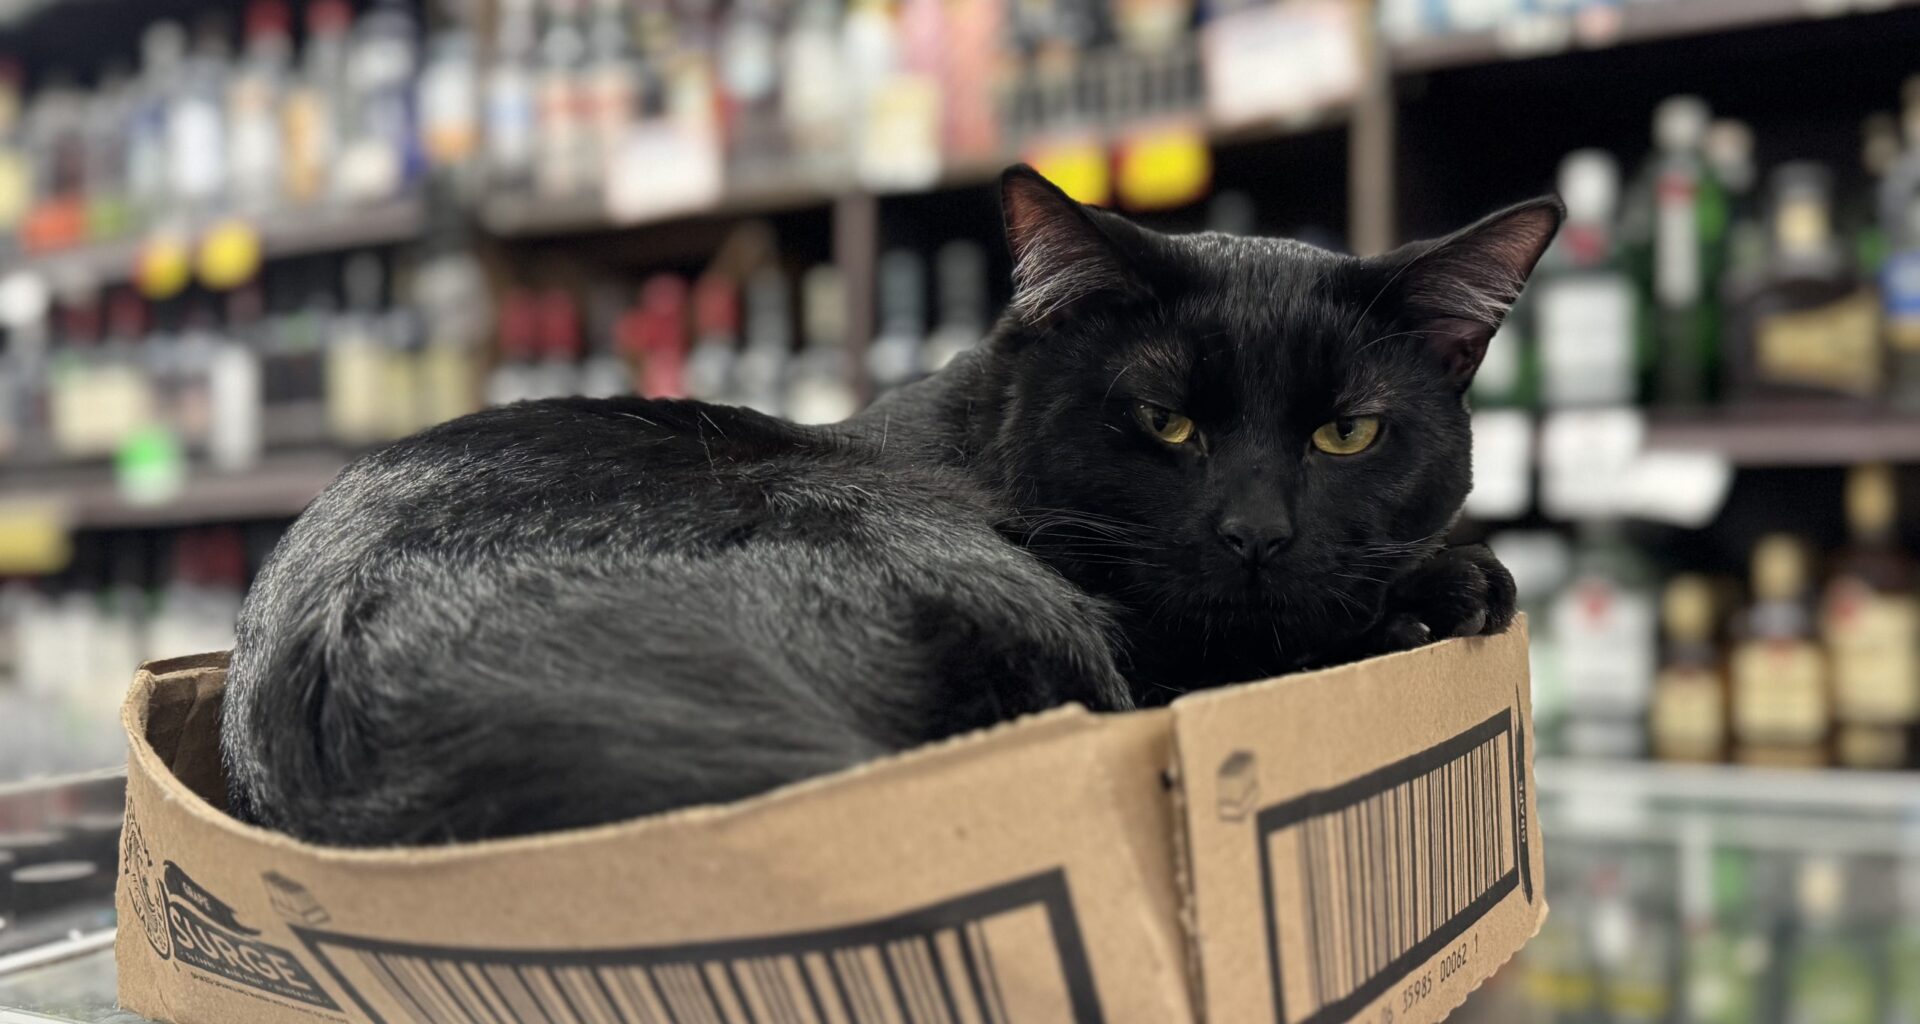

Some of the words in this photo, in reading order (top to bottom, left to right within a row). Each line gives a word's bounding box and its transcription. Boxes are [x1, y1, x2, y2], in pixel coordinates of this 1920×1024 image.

[1518, 780, 1526, 843] GRAPE
[169, 903, 313, 991] SURGE
[1402, 970, 1432, 1015] 35985
[1440, 942, 1468, 983] 00062
[1473, 932, 1479, 953] 1
